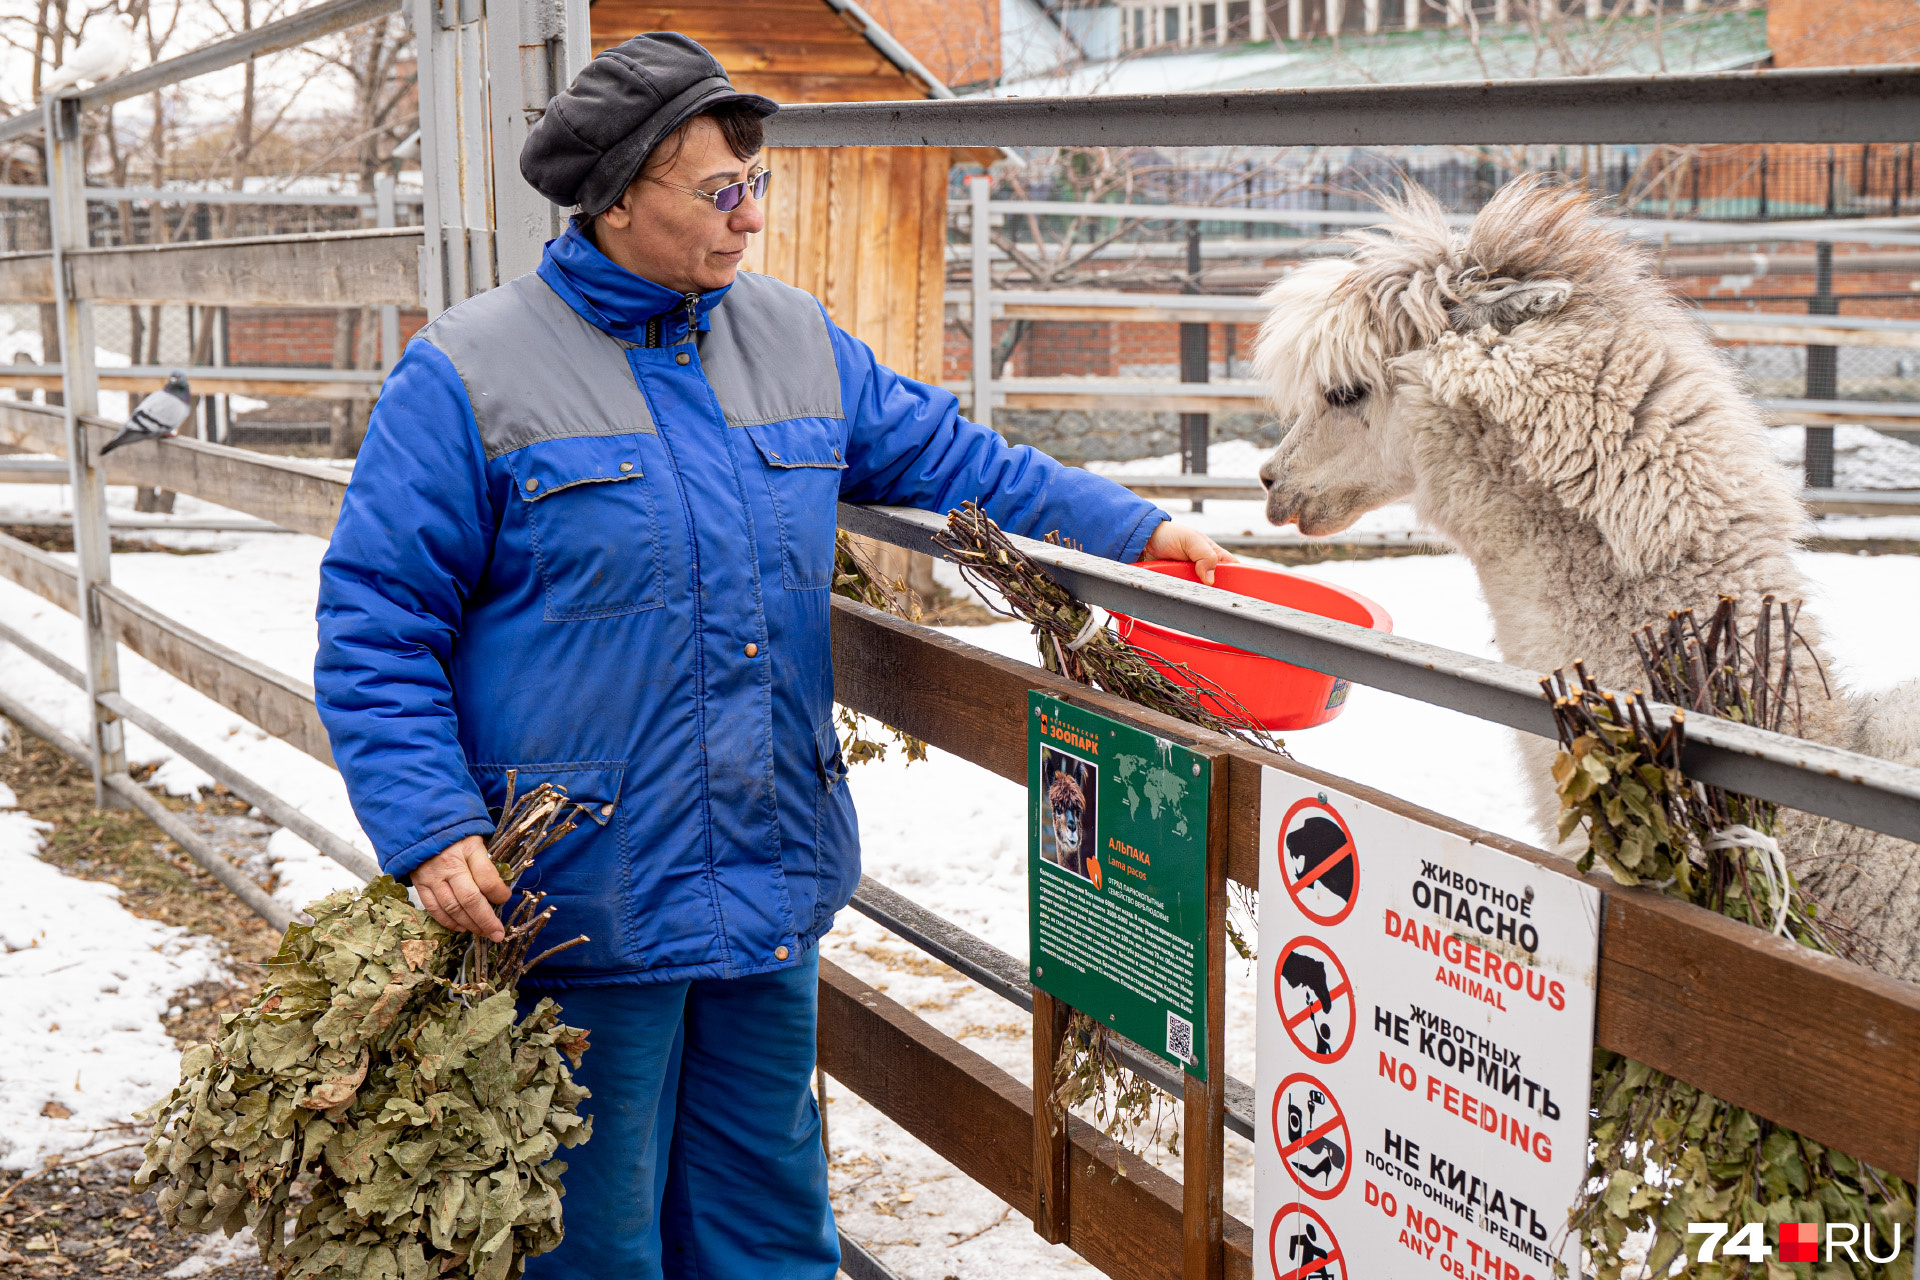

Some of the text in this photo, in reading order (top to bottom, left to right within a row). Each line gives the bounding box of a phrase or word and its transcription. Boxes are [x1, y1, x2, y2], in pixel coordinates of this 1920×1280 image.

[1050, 725, 1099, 755] ЗООПАРК
[1108, 837, 1151, 867] АЛЬПАКА
[1108, 854, 1147, 880] Lama pacos
[1107, 887, 1135, 905] СЕМЕЙСТВО
[1412, 880, 1539, 954] ОПАСНО
[1420, 859, 1532, 919] ЖИВОТНОЕ
[1385, 908, 1566, 1011] DANGEROUS
[1435, 965, 1507, 1013] ANIMAL
[1374, 1004, 1561, 1121] НЕ КОРМИТЬ
[1410, 1003, 1522, 1073] ЖИВОТНЫХ
[1378, 1050, 1552, 1163] NO FEEDING
[1365, 1149, 1567, 1268] ПОСТОРОННИЕ ПРЕДМЕТ
[1384, 1127, 1548, 1242] НЕ КИДАТЬ
[1364, 1179, 1537, 1280] DO NOT THR
[1398, 1228, 1434, 1261] ANY
